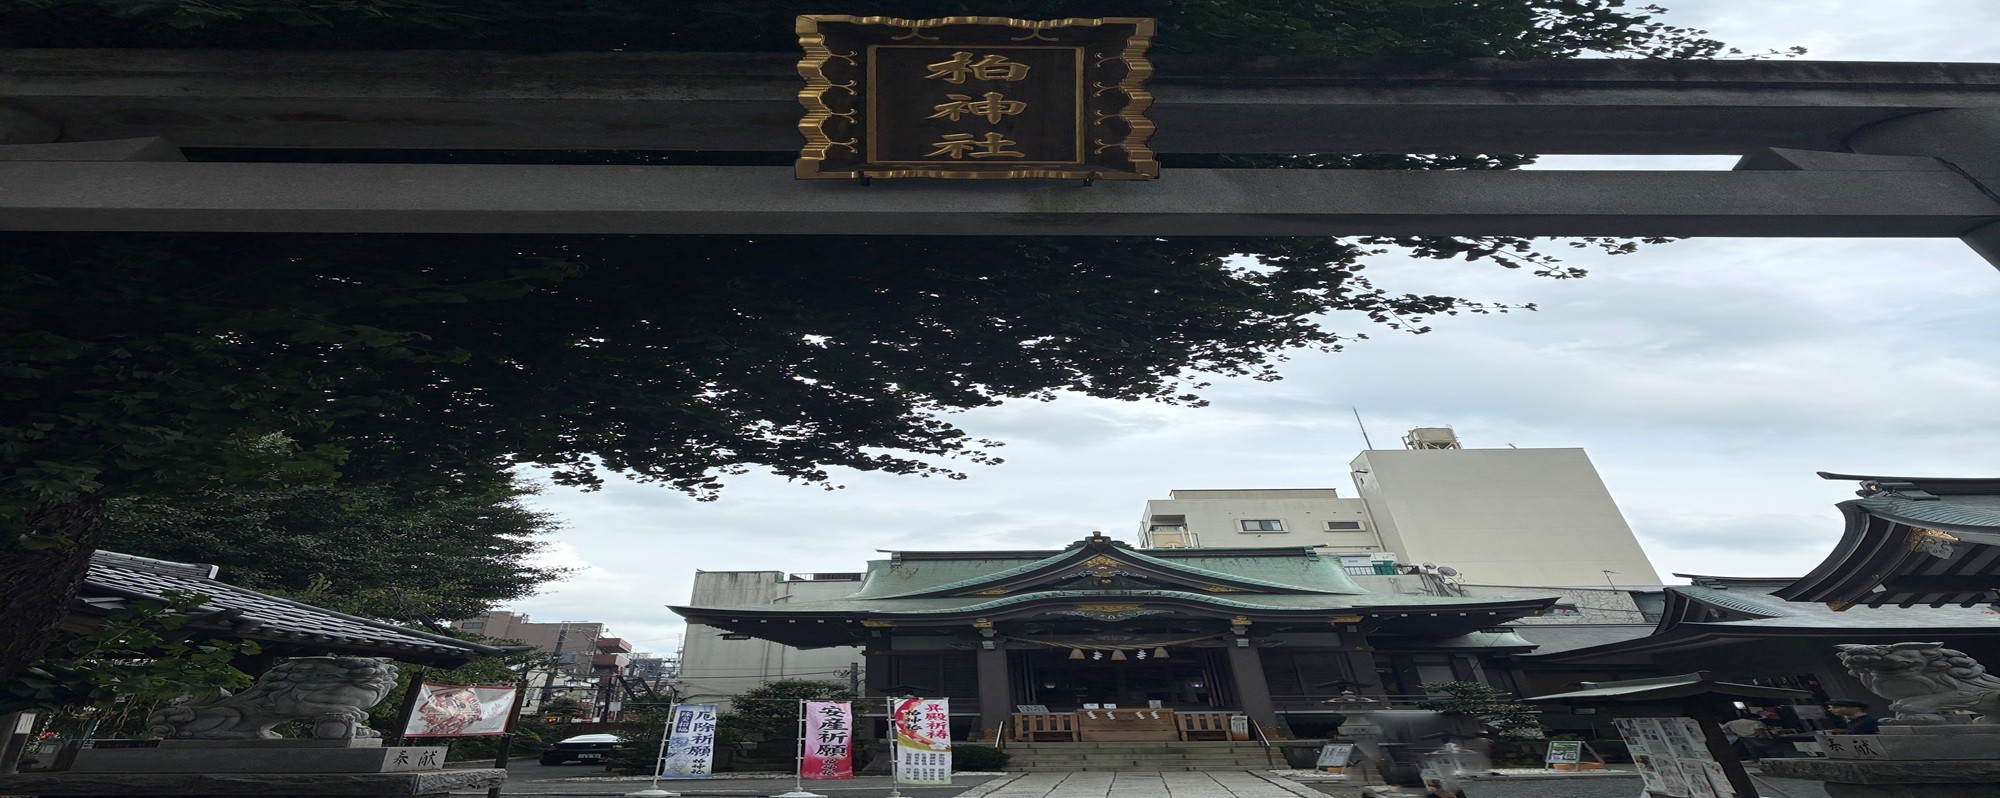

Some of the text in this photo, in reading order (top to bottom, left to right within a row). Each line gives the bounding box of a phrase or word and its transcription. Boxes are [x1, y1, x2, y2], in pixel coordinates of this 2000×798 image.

[925, 51, 1031, 159] 柏神社
[687, 711, 716, 757] 厄除祈願
[815, 705, 849, 757] 安産祈願
[924, 703, 948, 739] 昇殿祈祷
[393, 750, 438, 767] 奉献
[1827, 738, 1879, 756] 奉献
